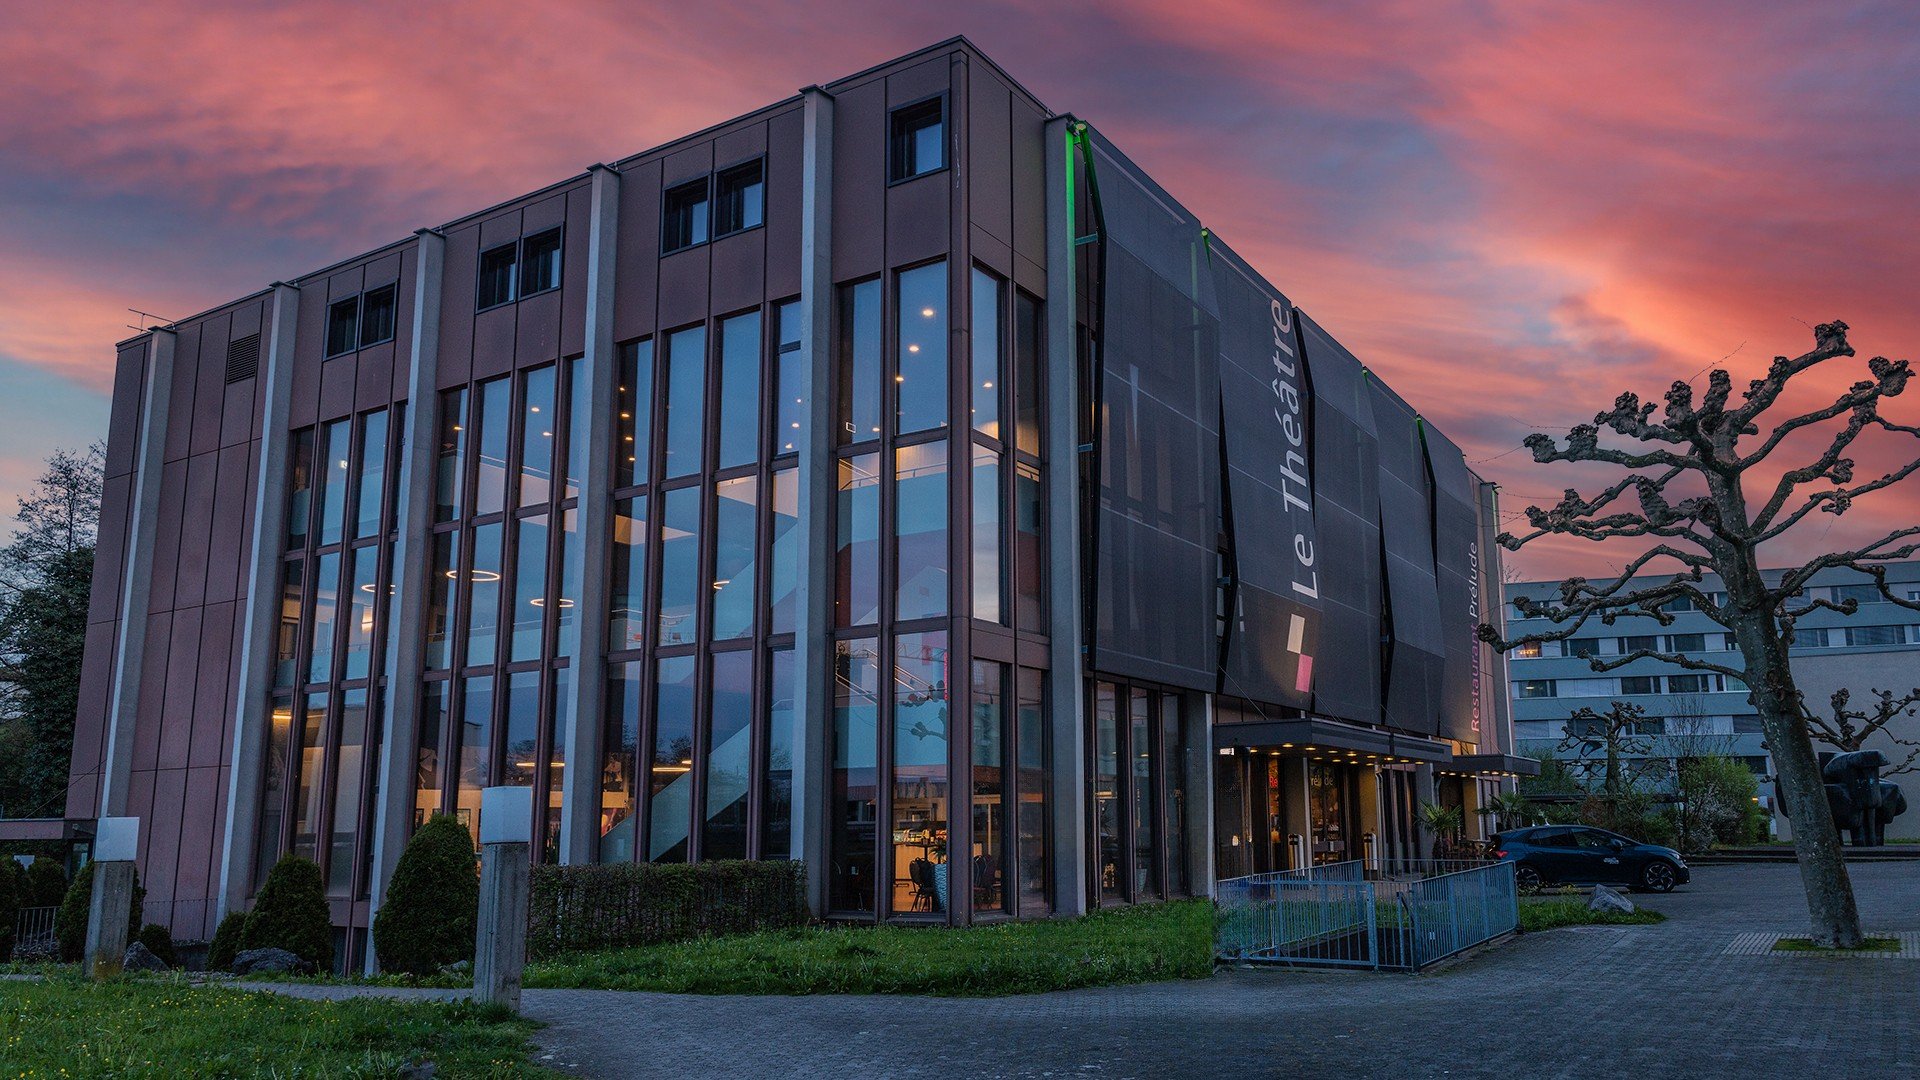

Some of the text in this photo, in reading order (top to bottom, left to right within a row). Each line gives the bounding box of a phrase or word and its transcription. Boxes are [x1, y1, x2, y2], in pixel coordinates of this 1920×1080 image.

[1270, 299, 1318, 600] Le Théâtre
[1469, 542, 1480, 732] Restaurant Prélude
